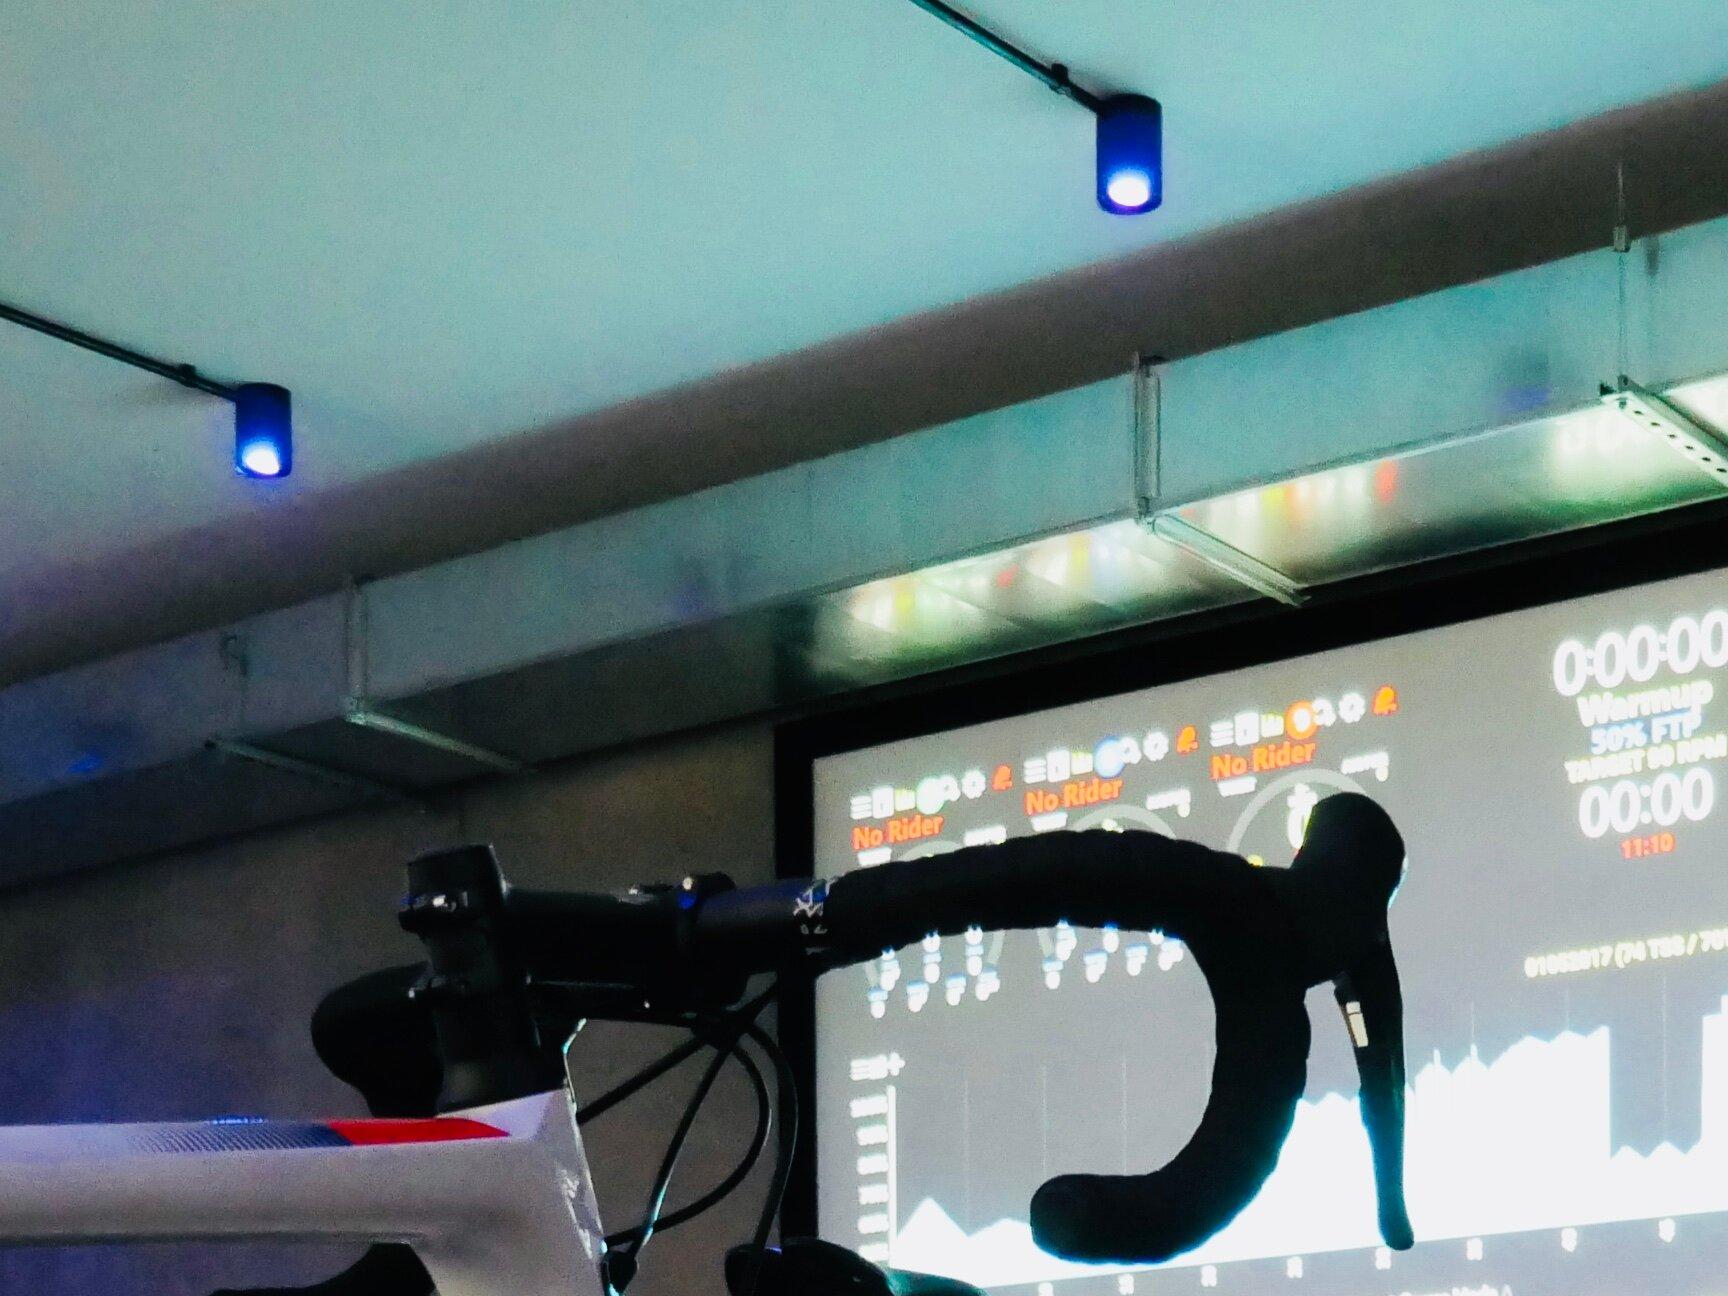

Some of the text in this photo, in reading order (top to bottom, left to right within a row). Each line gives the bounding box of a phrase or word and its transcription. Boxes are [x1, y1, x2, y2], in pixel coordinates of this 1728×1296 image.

[1577, 680, 1714, 727] Warmup
[1591, 711, 1703, 755] 50% FTP
[1209, 754, 1248, 780] No
[1251, 740, 1316, 773] Rider
[1024, 789, 1060, 816] No
[1063, 776, 1123, 807] Rider
[1579, 766, 1715, 838] 00:00
[851, 825, 884, 850] No
[886, 815, 944, 843] Rider
